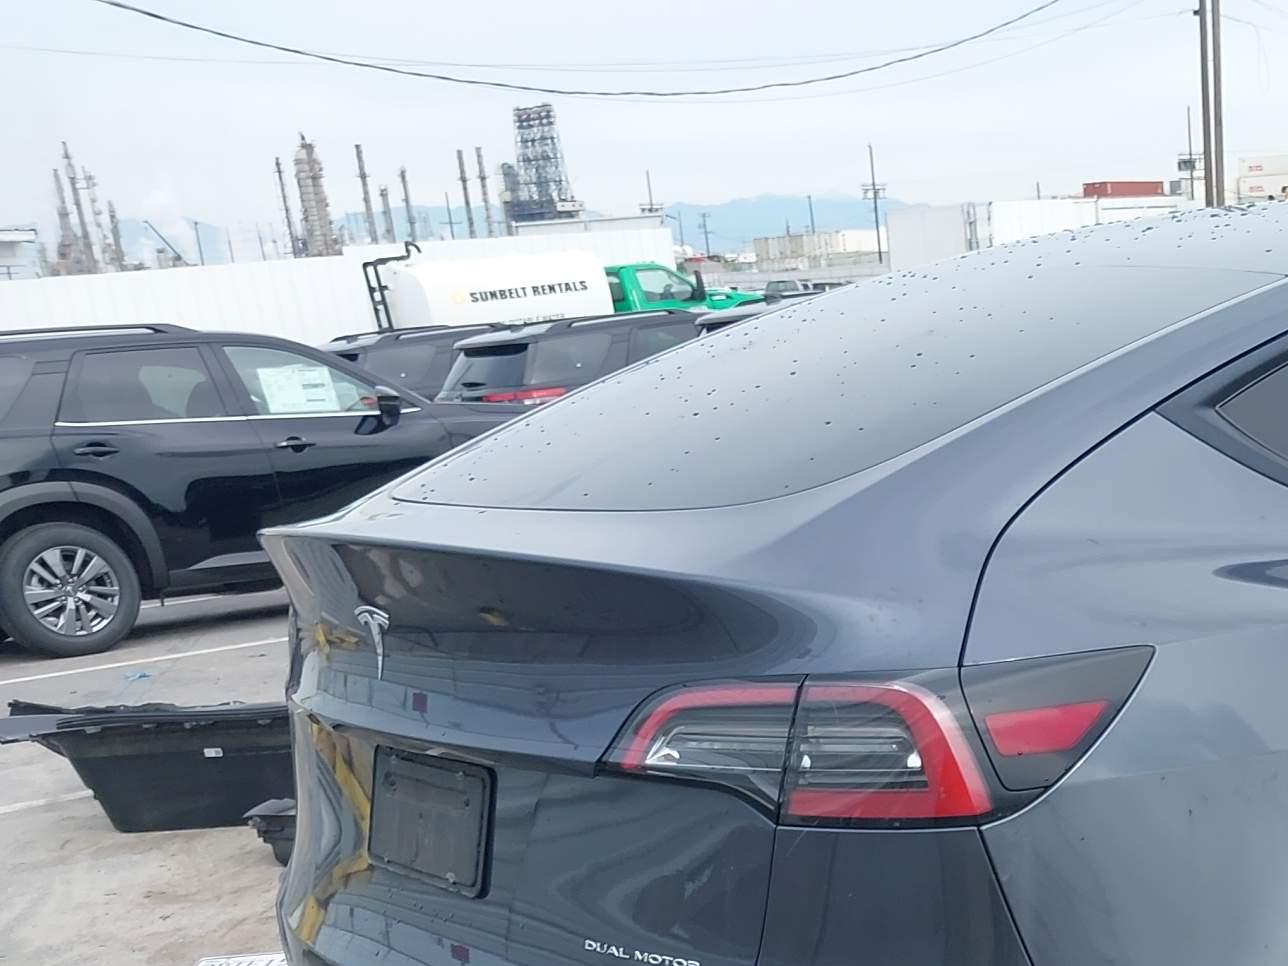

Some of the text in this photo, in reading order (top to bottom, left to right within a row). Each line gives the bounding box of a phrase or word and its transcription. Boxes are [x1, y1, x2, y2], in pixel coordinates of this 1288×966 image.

[469, 280, 589, 303] SUNBELT RENTALS
[584, 939, 630, 959] DUAL
